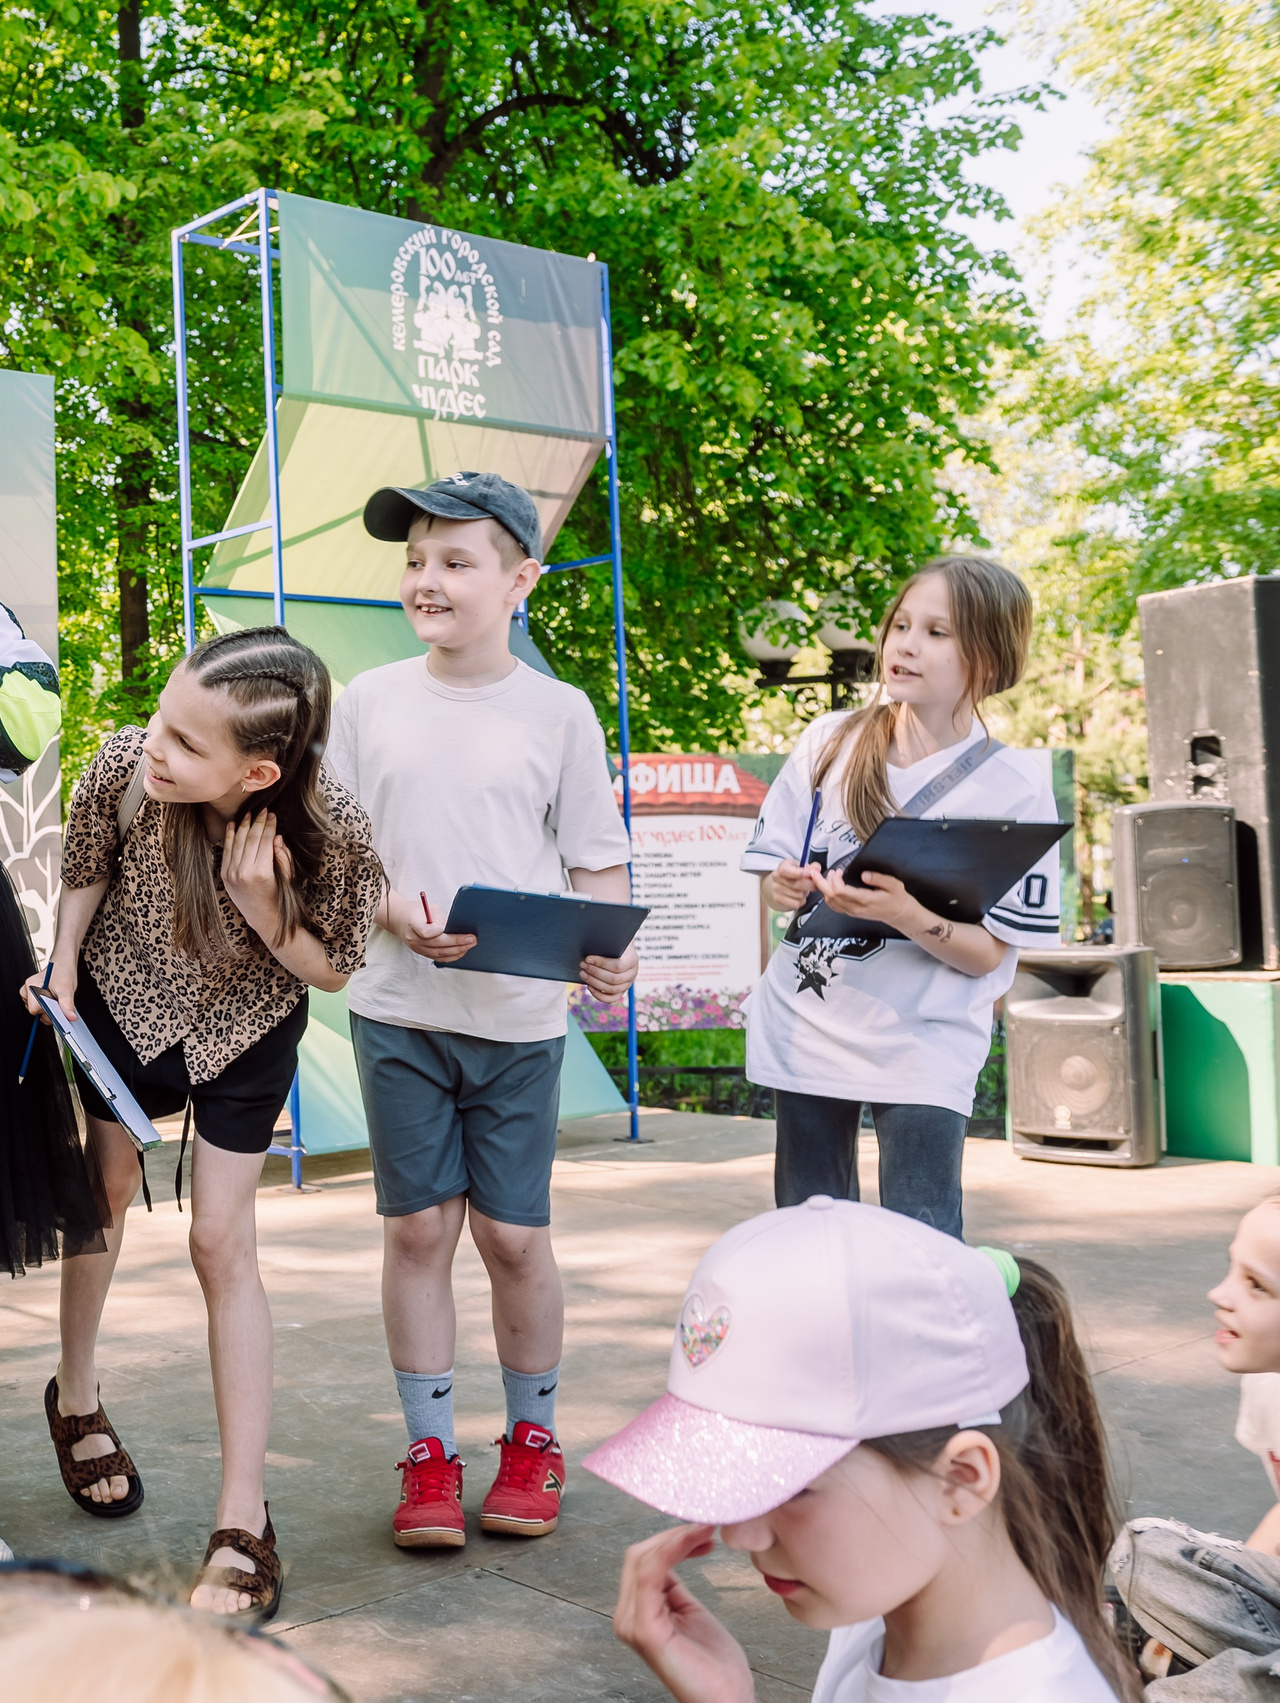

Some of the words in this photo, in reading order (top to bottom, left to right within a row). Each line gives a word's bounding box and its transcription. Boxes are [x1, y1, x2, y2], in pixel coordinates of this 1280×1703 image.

[419, 246, 456, 281] 100
[417, 354, 480, 395] ПАРК
[411, 383, 487, 421] ЧУДЕС
[699, 824, 727, 842] 100
